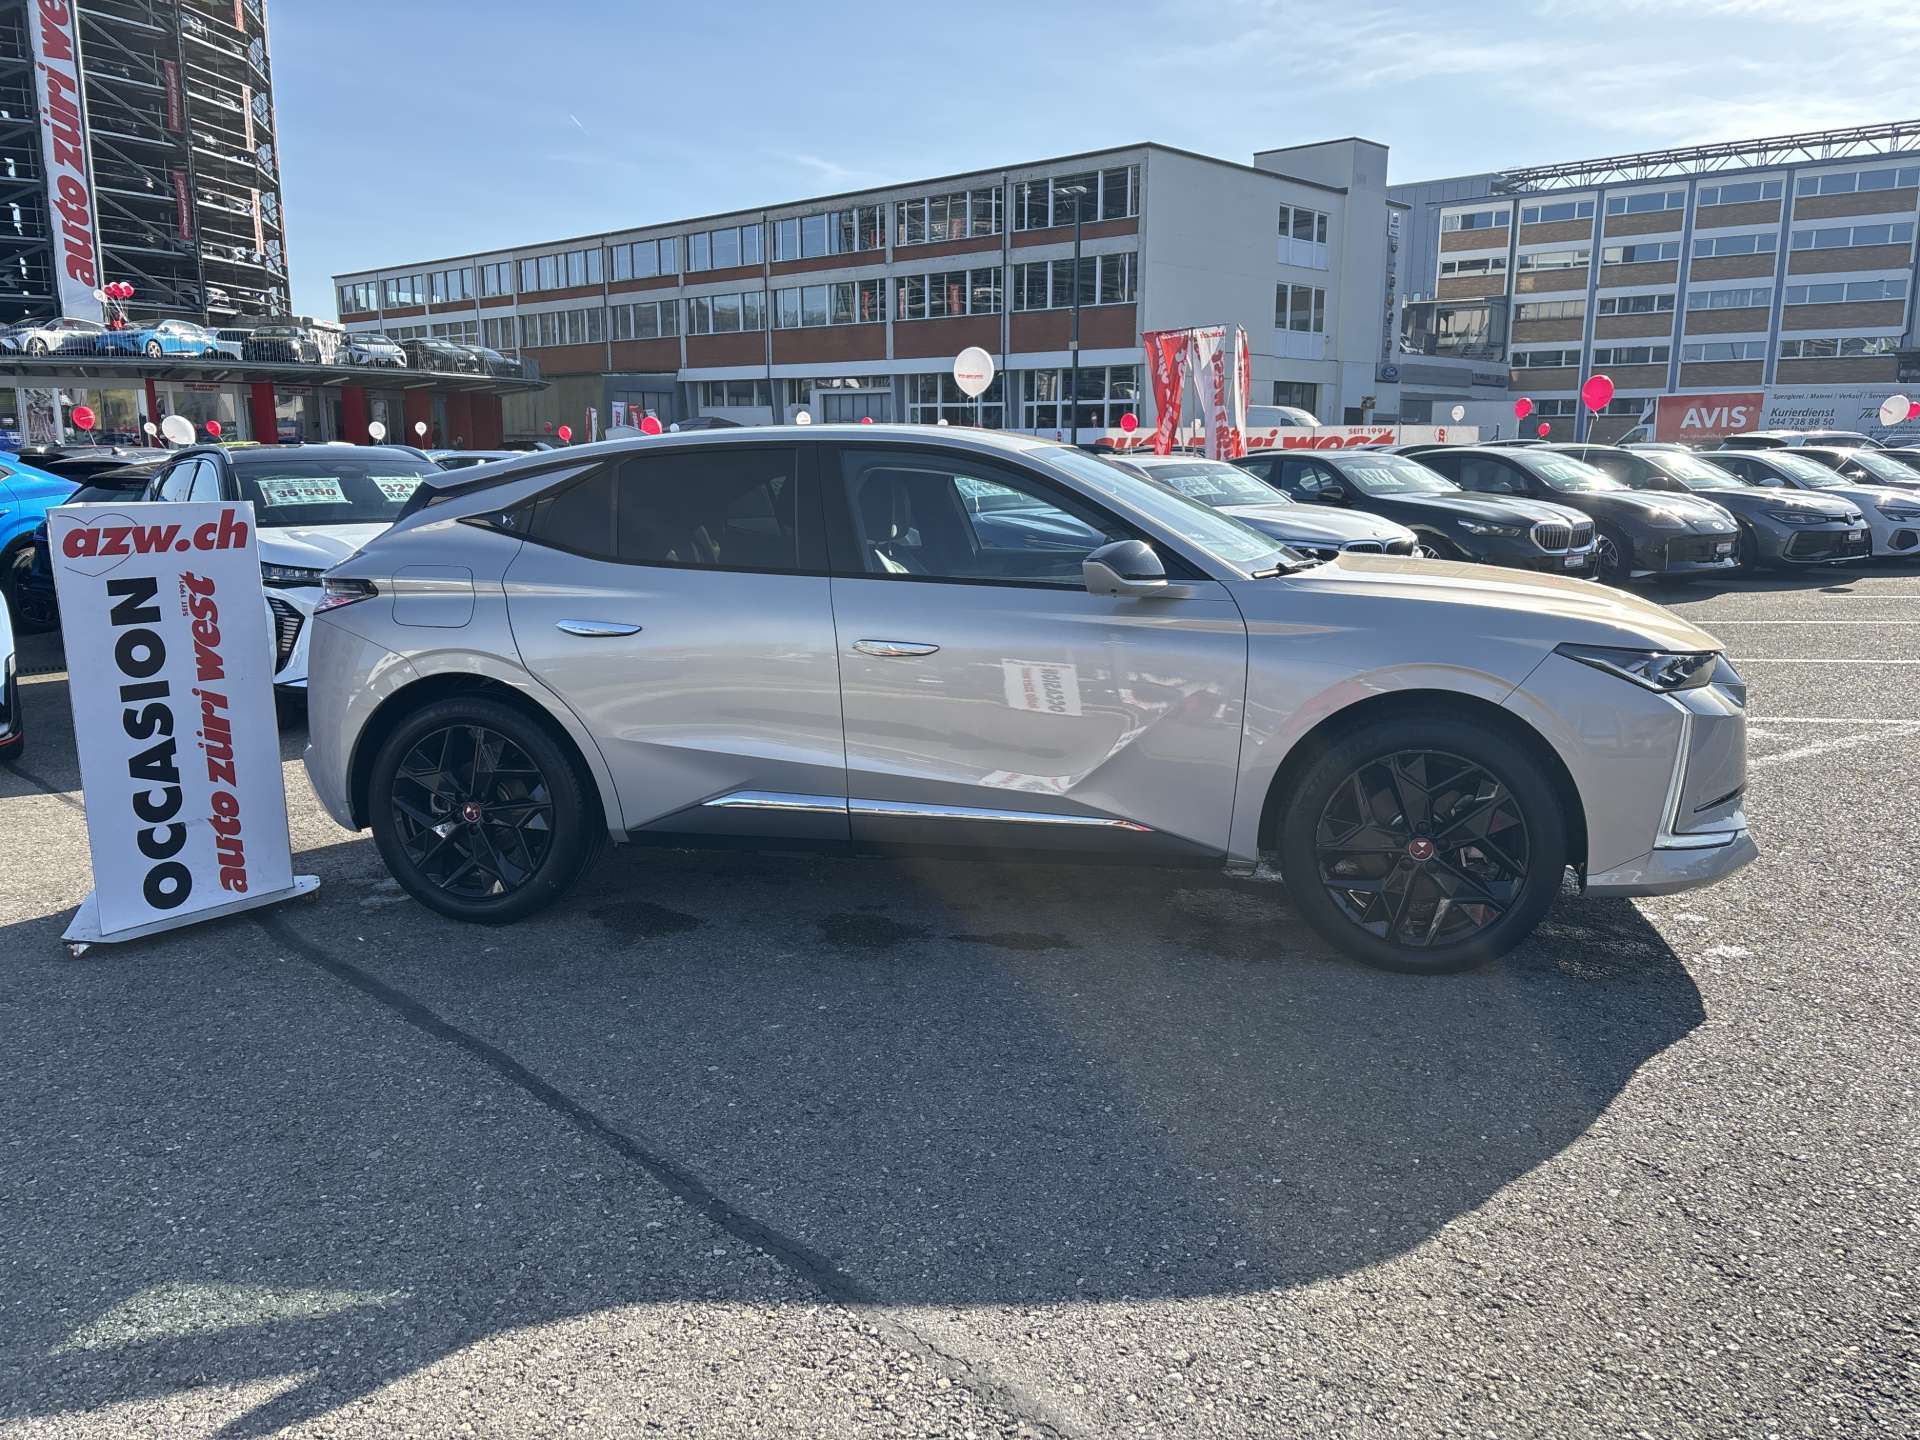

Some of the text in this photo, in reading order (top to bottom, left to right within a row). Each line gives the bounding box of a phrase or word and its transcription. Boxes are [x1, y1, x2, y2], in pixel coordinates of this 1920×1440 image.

[38, 61, 85, 177] züri
[53, 175, 96, 288] auto
[1367, 427, 1388, 435] 1991
[1680, 406, 1747, 429] AVIS
[1769, 418, 1835, 426] 044 738 88 50
[1770, 408, 1835, 417] Kurierdienst
[276, 488, 337, 498] 35'550
[62, 509, 249, 559] azw.ch
[178, 580, 189, 617] SEIT 1991
[106, 576, 193, 910] OCCASION
[178, 570, 249, 893] auto züri west
